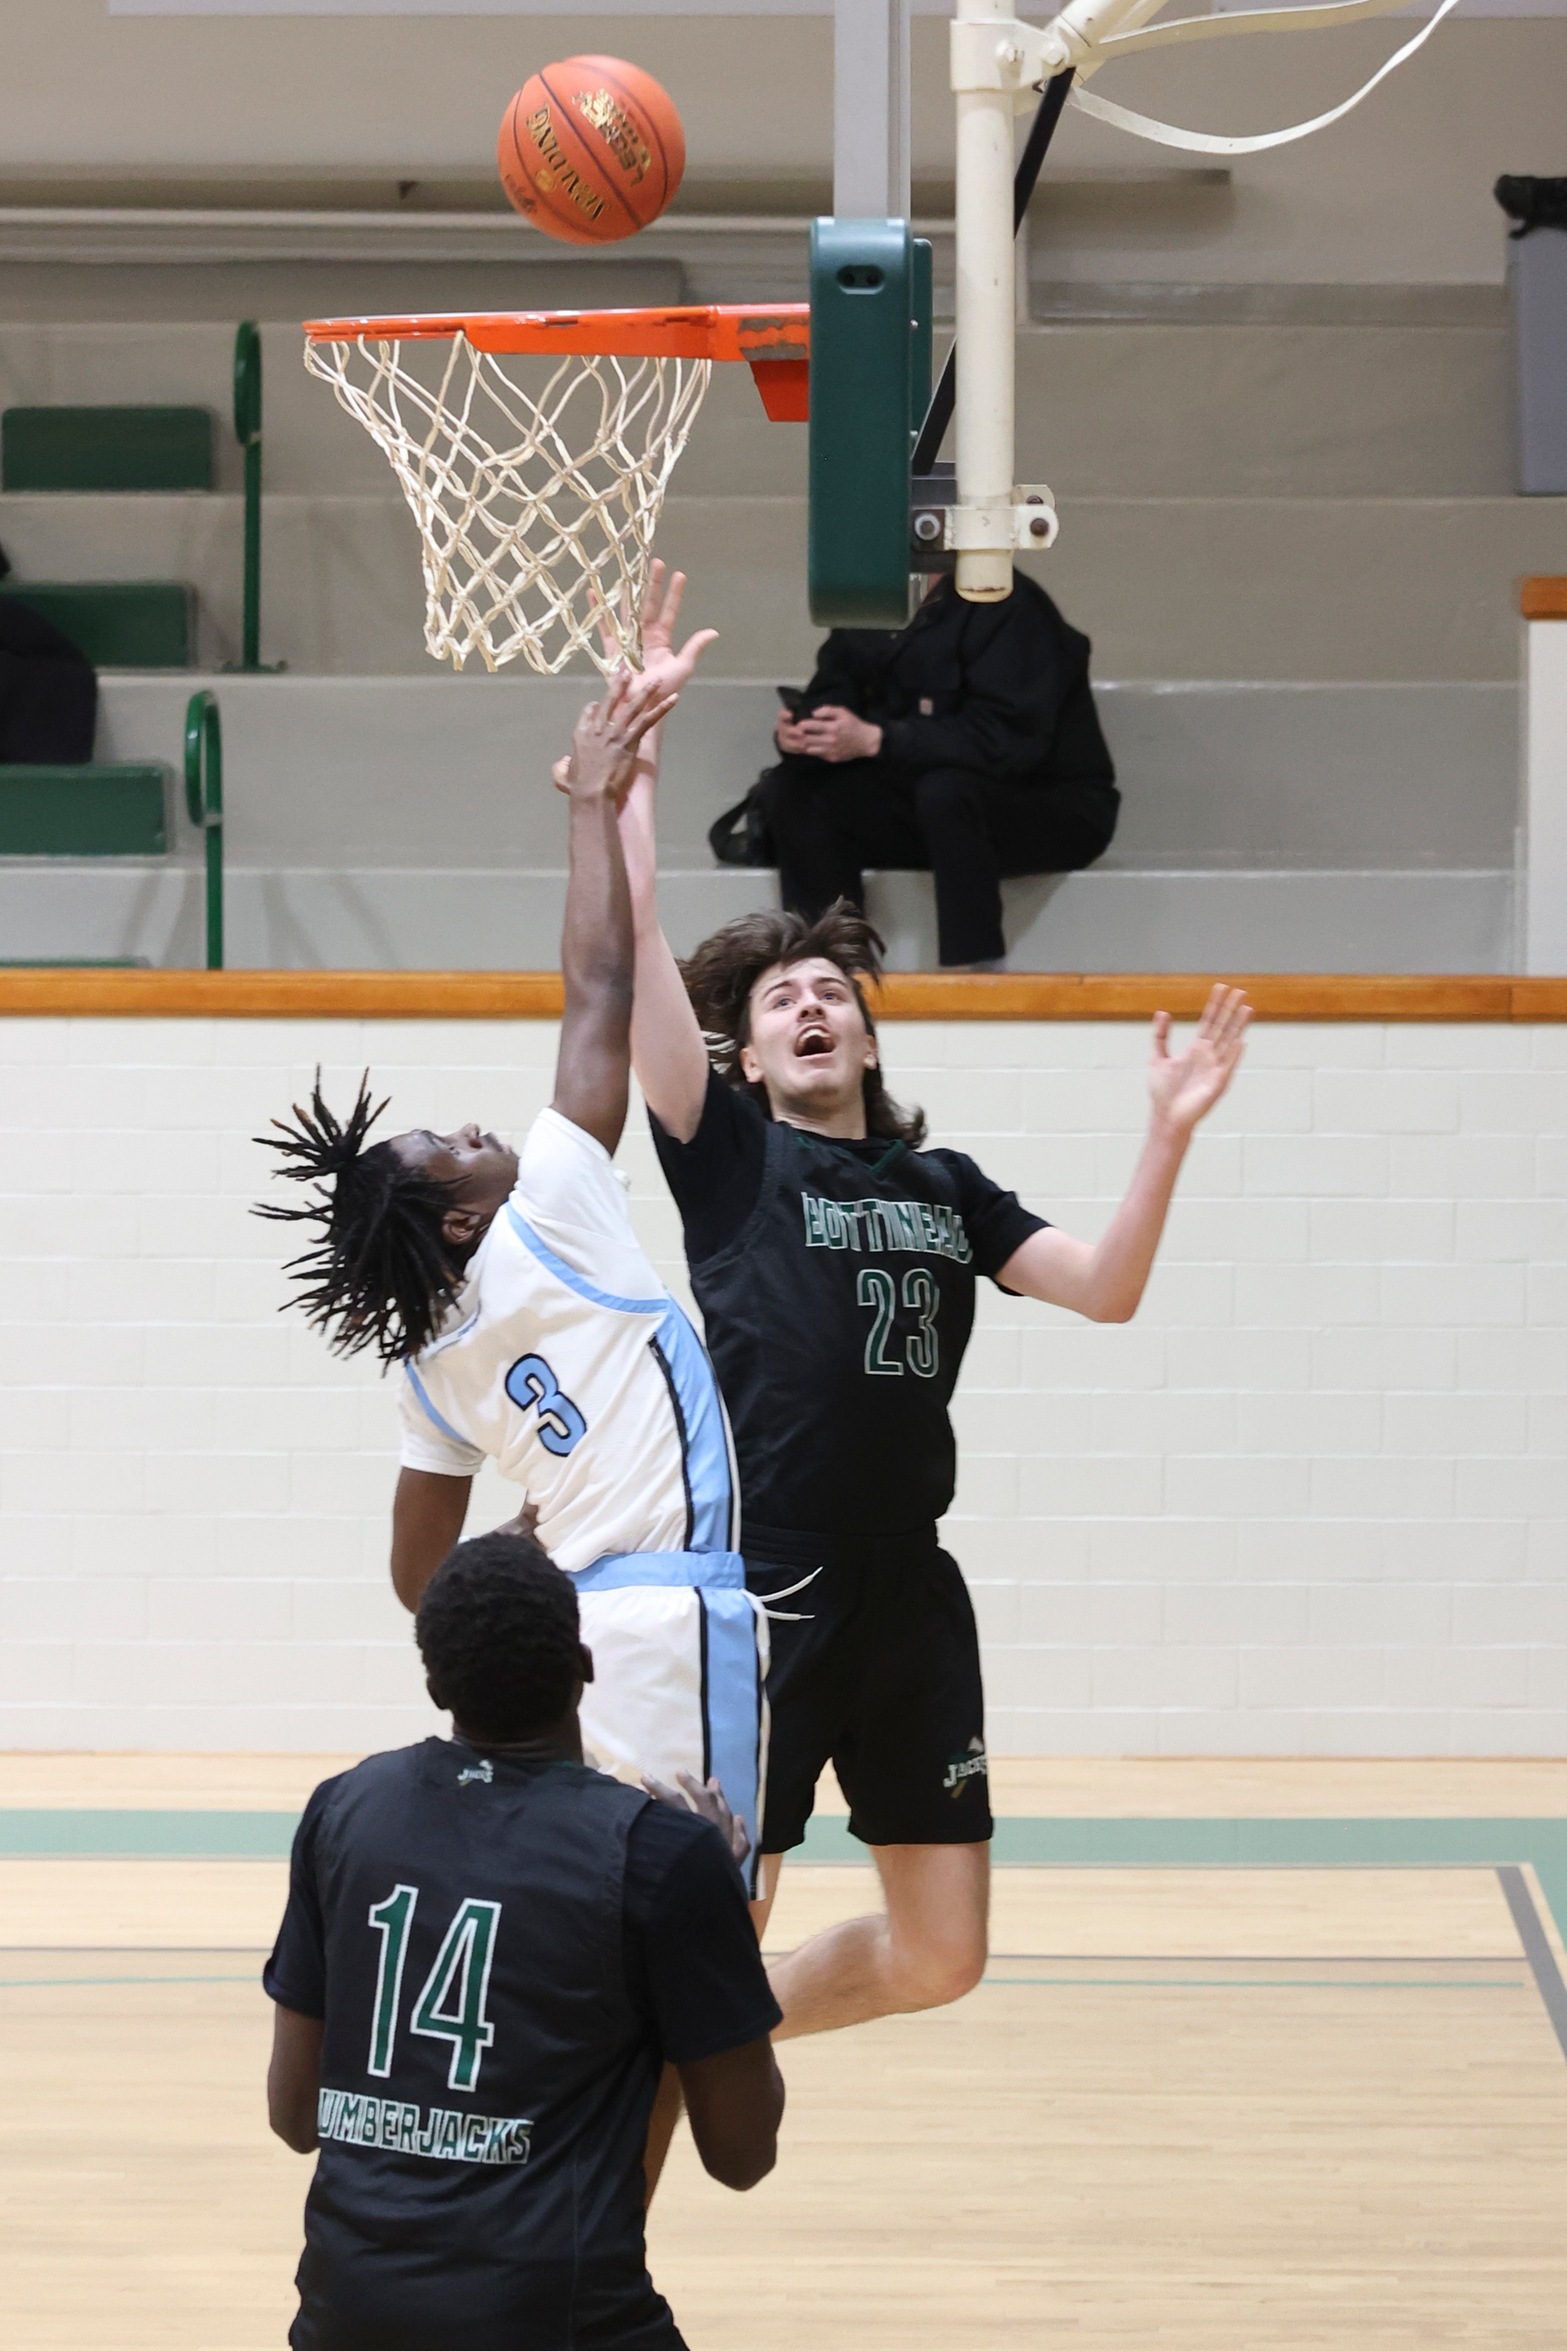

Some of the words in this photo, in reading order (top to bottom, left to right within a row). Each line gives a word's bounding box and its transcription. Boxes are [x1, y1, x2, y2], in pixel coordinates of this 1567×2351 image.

[857, 1268, 941, 1378] 23
[505, 1353, 587, 1457] 3
[368, 1884, 502, 2093] 14
[318, 2088, 534, 2164] UMBERJACKS
